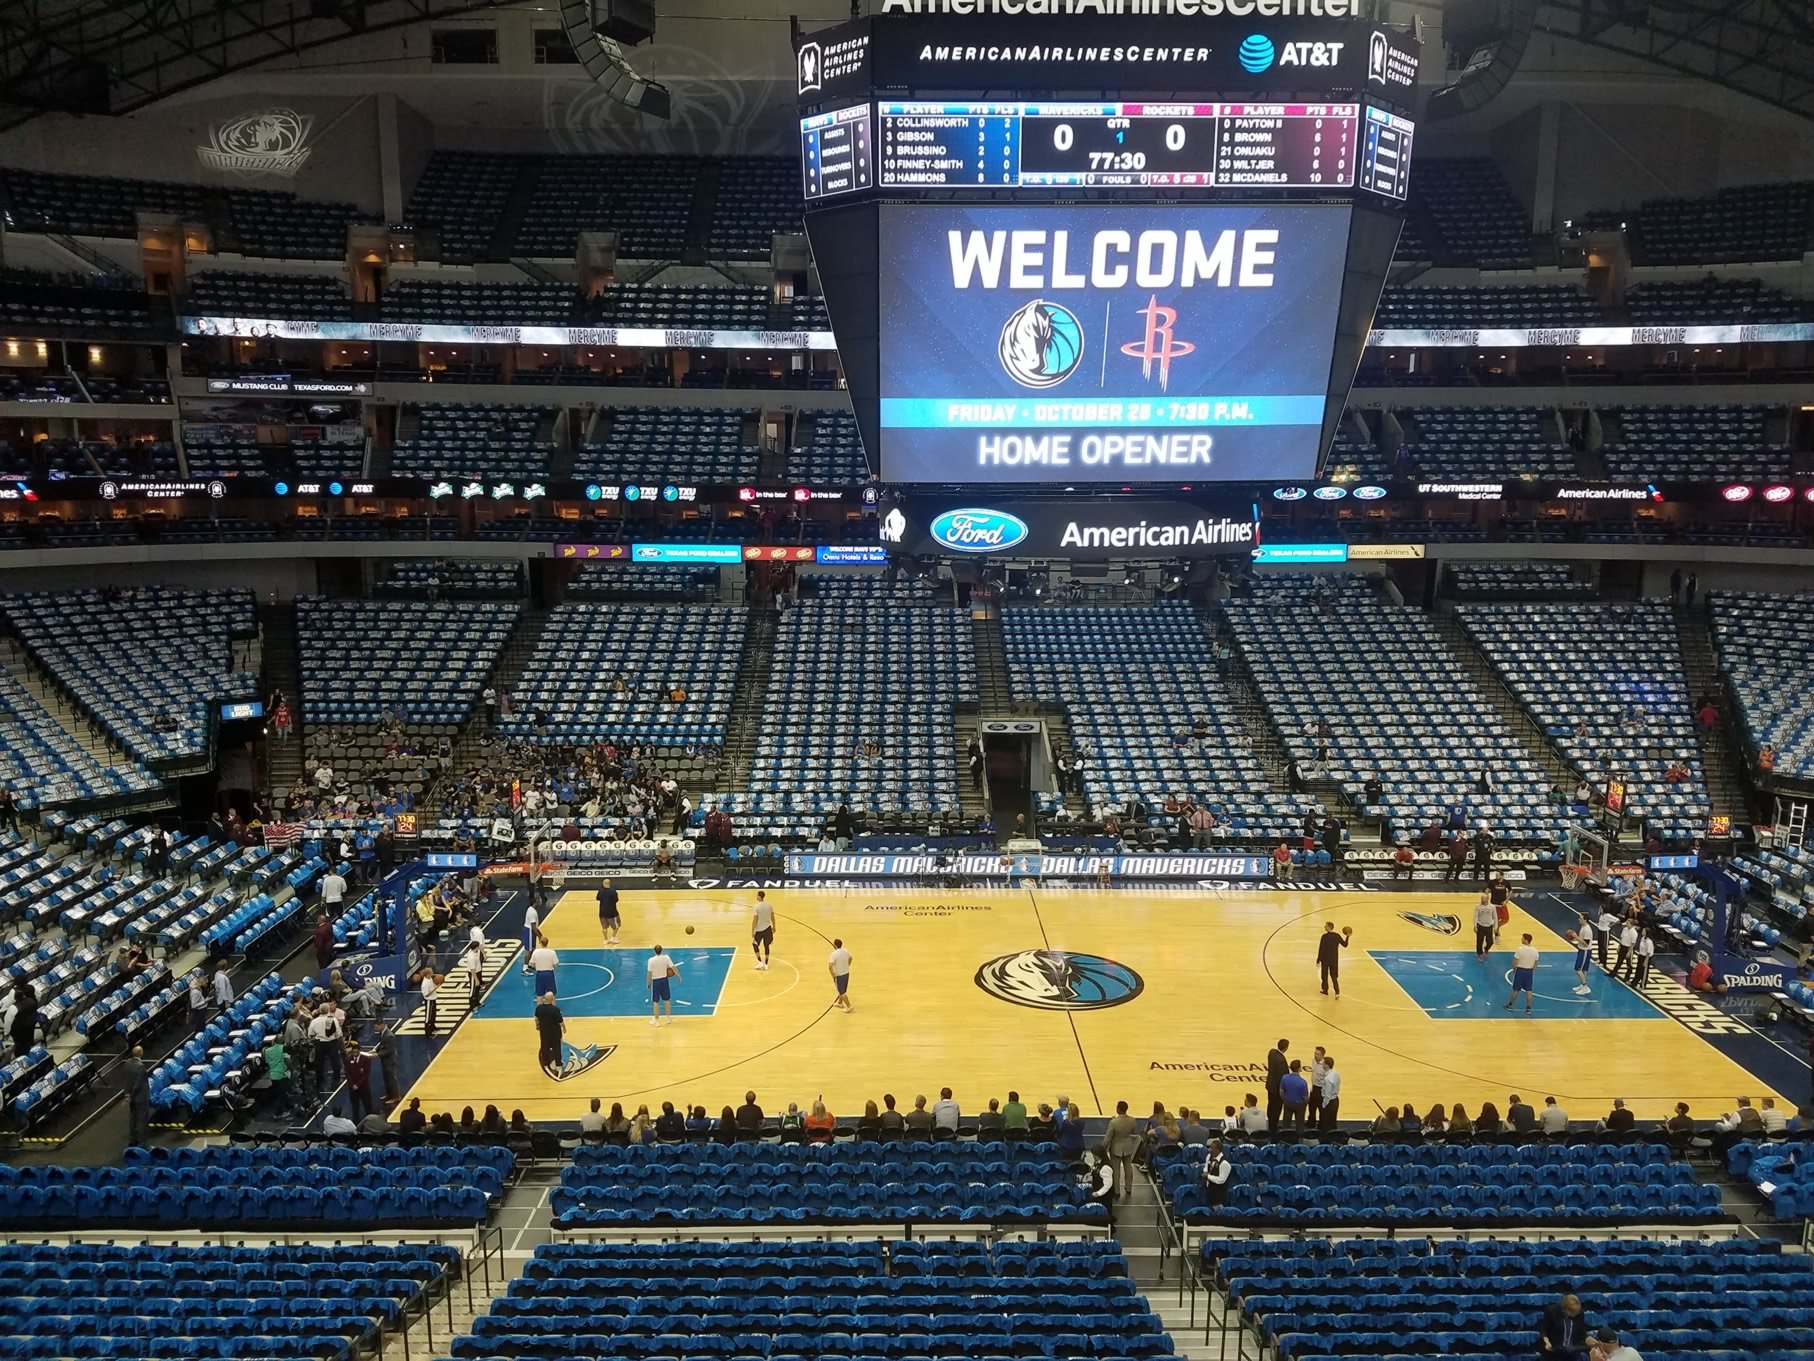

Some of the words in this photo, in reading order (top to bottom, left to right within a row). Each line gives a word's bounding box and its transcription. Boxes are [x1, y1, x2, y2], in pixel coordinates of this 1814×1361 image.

[823, 35, 869, 57] AMERICAN
[823, 49, 865, 68] AIRLINES
[919, 45, 1210, 63] AMERICANAIRLINESCENTER
[1279, 42, 1344, 67] AT&T
[1388, 46, 1419, 68] AMERICAN
[823, 63, 859, 80] CENTER
[1387, 58, 1416, 77] AIRLINES
[1386, 69, 1412, 87] CENTER
[903, 105, 945, 114] PLAYER
[1039, 106, 1104, 116] MAVERICKS
[1142, 106, 1195, 116] ROCKETS
[1243, 106, 1285, 115] PLAYER
[1306, 106, 1327, 115] PTS
[1332, 106, 1352, 115] FLS
[886, 118, 892, 127] 2
[896, 118, 969, 127] COLLINSWORTH
[978, 118, 985, 128] 0
[1004, 118, 1011, 128] 2
[1107, 118, 1130, 129] QTR
[1224, 119, 1230, 128] 0
[1235, 119, 1275, 128] PAYTON
[1315, 119, 1322, 128] 0
[1342, 119, 1348, 128] 1
[886, 132, 892, 141] 3
[896, 132, 934, 141] GIBSON
[978, 132, 985, 141] 3
[1005, 132, 1010, 141] 1
[1053, 124, 1074, 151] 0
[1115, 131, 1124, 144] 1
[1166, 124, 1186, 151] 0
[1234, 133, 1272, 142] BROWN
[1341, 133, 1347, 142] 1
[886, 146, 892, 155] 9
[896, 146, 946, 155] BRUSSINO
[978, 146, 984, 155] 2
[1003, 146, 1010, 155] 0
[1221, 147, 1231, 156] 21
[1234, 147, 1275, 156] ONUAKU
[1313, 147, 1320, 156] 0
[1340, 147, 1346, 156] 1
[884, 160, 895, 169] 10
[896, 160, 963, 169] FINNEY-SMITH
[977, 160, 984, 169] 4
[1003, 160, 1010, 169] 0
[1088, 152, 1146, 170] 77:30
[1219, 160, 1231, 169] 30
[1233, 160, 1275, 169] WILTJER
[1338, 160, 1344, 169] 0
[883, 173, 895, 182] 20
[896, 173, 946, 182] HAMMONS
[1003, 173, 1009, 182] 0
[1087, 173, 1095, 184] 0
[1102, 176, 1132, 184] FOULS
[1140, 173, 1148, 184] 0
[1218, 173, 1230, 182] 32
[1232, 173, 1288, 182] MCDANIELS
[1310, 173, 1321, 182] 10
[1337, 173, 1344, 183] 0
[947, 229, 1279, 289] WELCOME
[369, 323, 422, 340] MERCYME
[470, 327, 521, 343] MERCYME
[568, 328, 618, 345] MERCYME
[664, 330, 714, 346] MERCYME
[759, 331, 809, 347] MERCYME
[1429, 330, 1479, 346] MERCYME
[1527, 329, 1581, 345] MERCYME
[1631, 328, 1685, 343] MERCYME
[293, 384, 353, 392] TEXASFORD.COM
[948, 404, 1017, 422] FRIDAY
[1035, 403, 1123, 421] OCTOBER
[1169, 402, 1209, 420] 7:30
[1214, 402, 1254, 420] P.M.
[978, 435, 1071, 465] HOME
[1080, 435, 1212, 464] OPENER
[297, 483, 320, 493] AT&T
[352, 483, 374, 493] AT&T
[601, 486, 619, 495] TXU
[640, 487, 658, 495] TXU
[678, 487, 697, 495] TXU
[1418, 484, 1431, 493] UT
[1431, 484, 1503, 493] SOUTHWESTERN
[1458, 492, 1481, 500] Medical
[1481, 492, 1502, 500] Center
[1557, 488, 1607, 499] American
[1607, 488, 1647, 499] Airlines
[946, 514, 1006, 544] Ford
[1059, 520, 1191, 548] American
[1191, 519, 1253, 545] Airlines
[841, 553, 862, 561] Hotels
[1350, 549, 1383, 557] American
[1383, 548, 1410, 556] Airlines
[231, 709, 254, 718] LIGHT
[813, 856, 885, 874] DALLAS
[1120, 857, 1246, 876] MAVERICKS
[727, 879, 859, 889] FANDUEL
[1239, 881, 1379, 891] FANDUEL
[1723, 973, 1783, 988] SPALDING
[1209, 1072, 1268, 1083] Cente
